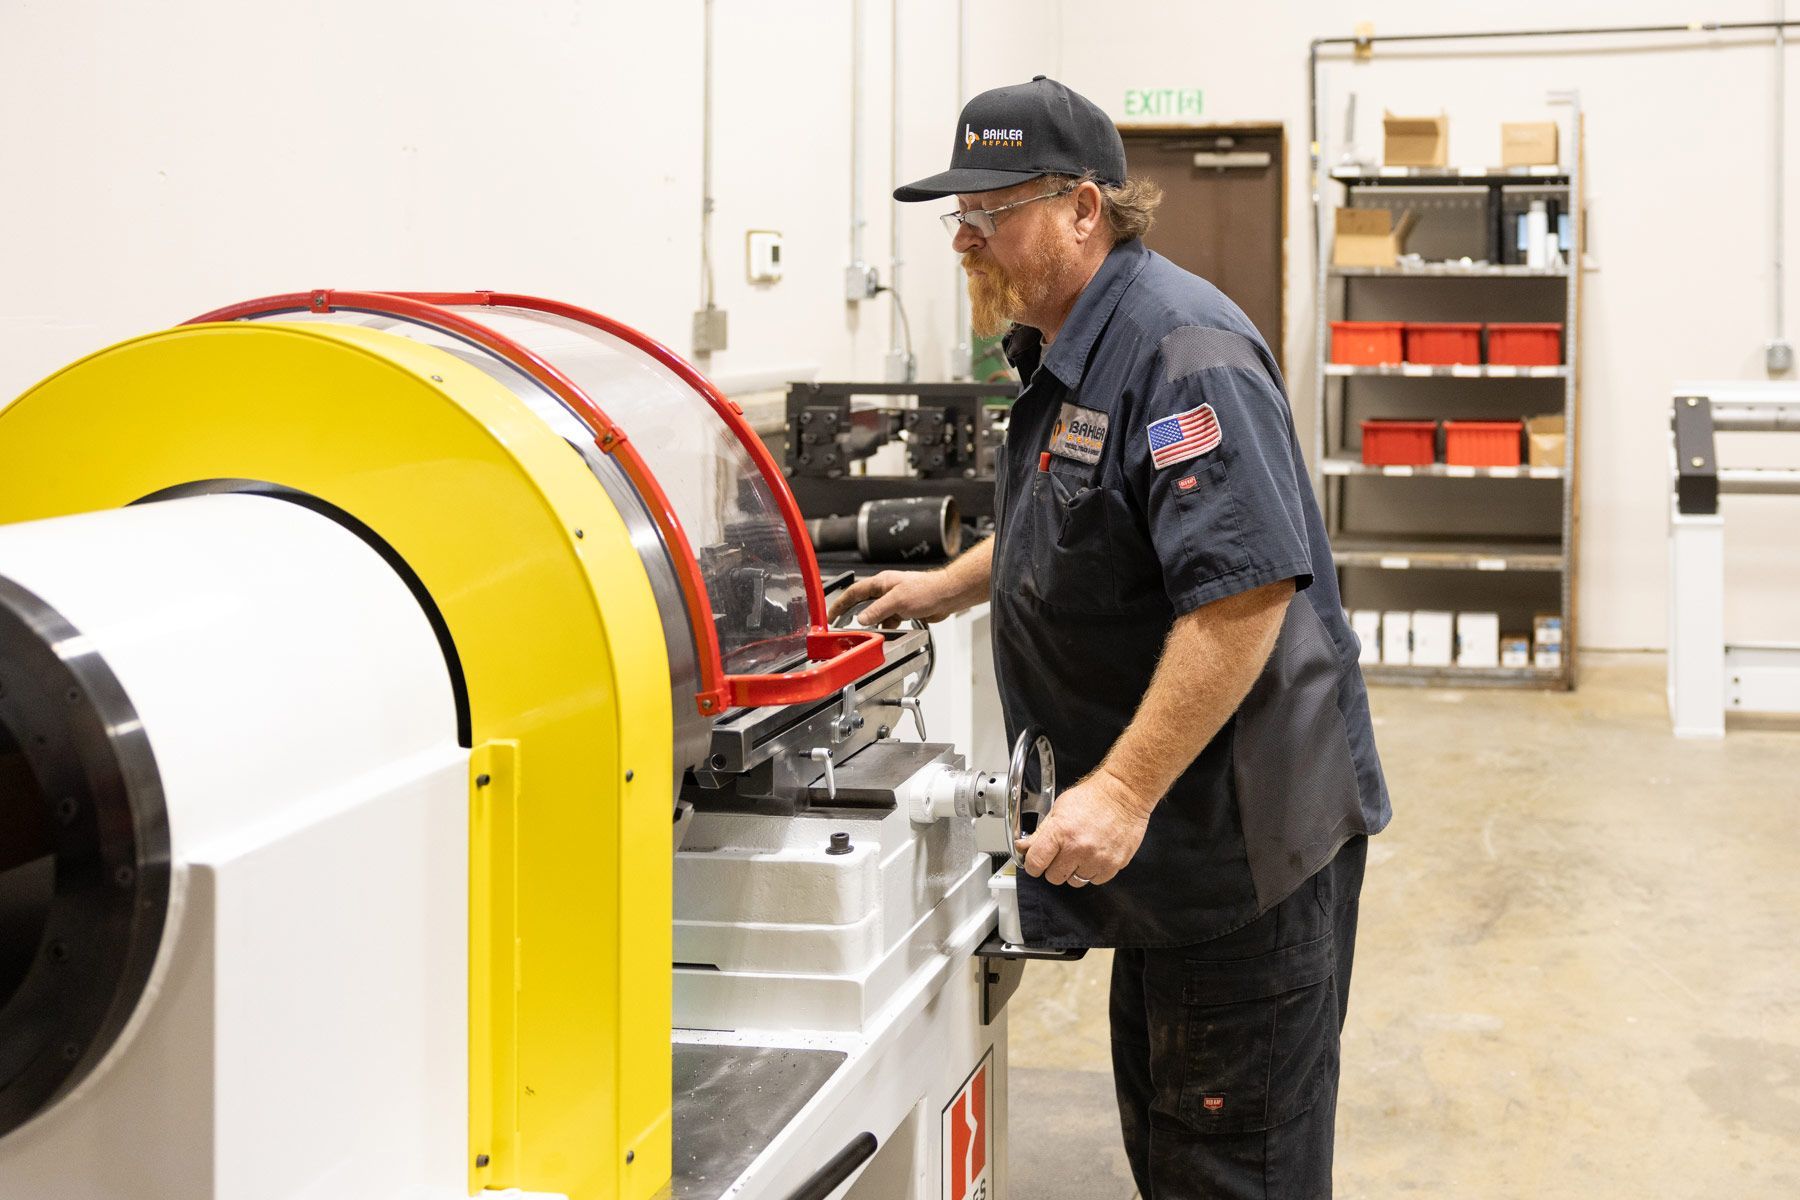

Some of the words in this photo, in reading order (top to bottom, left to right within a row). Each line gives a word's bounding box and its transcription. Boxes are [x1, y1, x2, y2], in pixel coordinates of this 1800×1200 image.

[1124, 89, 1175, 115] EXIT
[982, 129, 1023, 140] BAHLER
[1069, 420, 1106, 441] BAHLER
